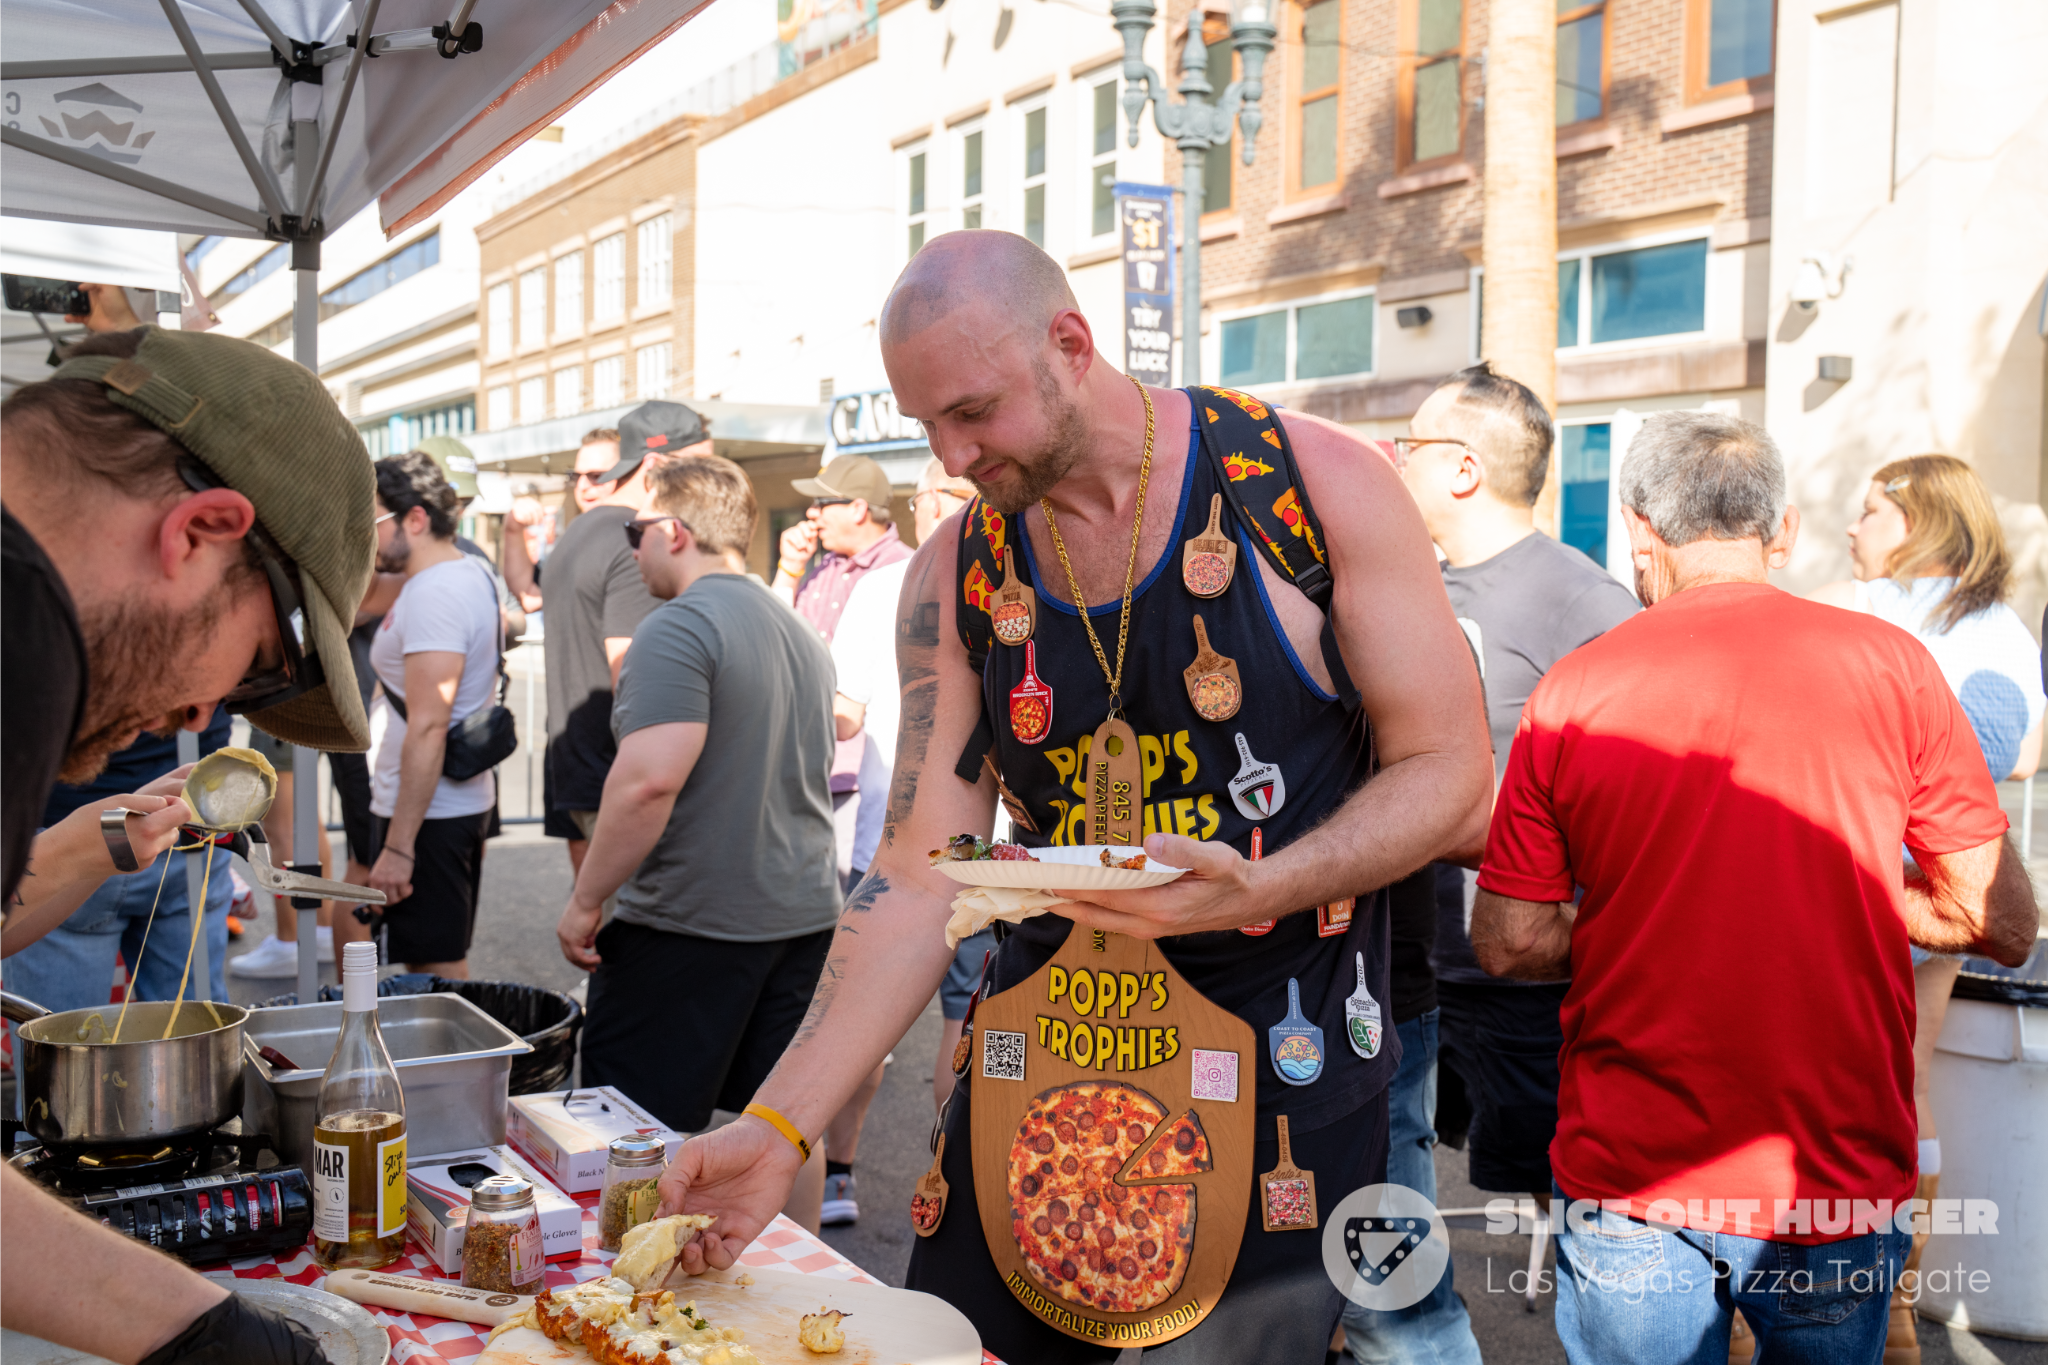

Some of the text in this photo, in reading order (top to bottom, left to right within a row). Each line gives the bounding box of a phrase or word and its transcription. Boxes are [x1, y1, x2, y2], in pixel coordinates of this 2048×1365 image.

[1131, 307, 1162, 329] TRY
[1127, 328, 1171, 351] YOUR
[1128, 350, 1169, 373] LUCK
[1044, 729, 1198, 799] POP'S
[1233, 765, 1273, 785] Scotto's
[1332, 911, 1349, 923] DOIN
[1357, 963, 1365, 986] 2026
[1048, 964, 1169, 1020] POPP'S
[1035, 1014, 1181, 1073] TROPHIES
[577, 1169, 597, 1179] Black
[1267, 1168, 1303, 1181] Anto's
[552, 1228, 578, 1239] Gloves
[417, 1287, 443, 1295] OUT
[444, 1291, 478, 1301] SLICE
[1006, 1270, 1205, 1341] IMMORTALIZE YOUR FOOD!
